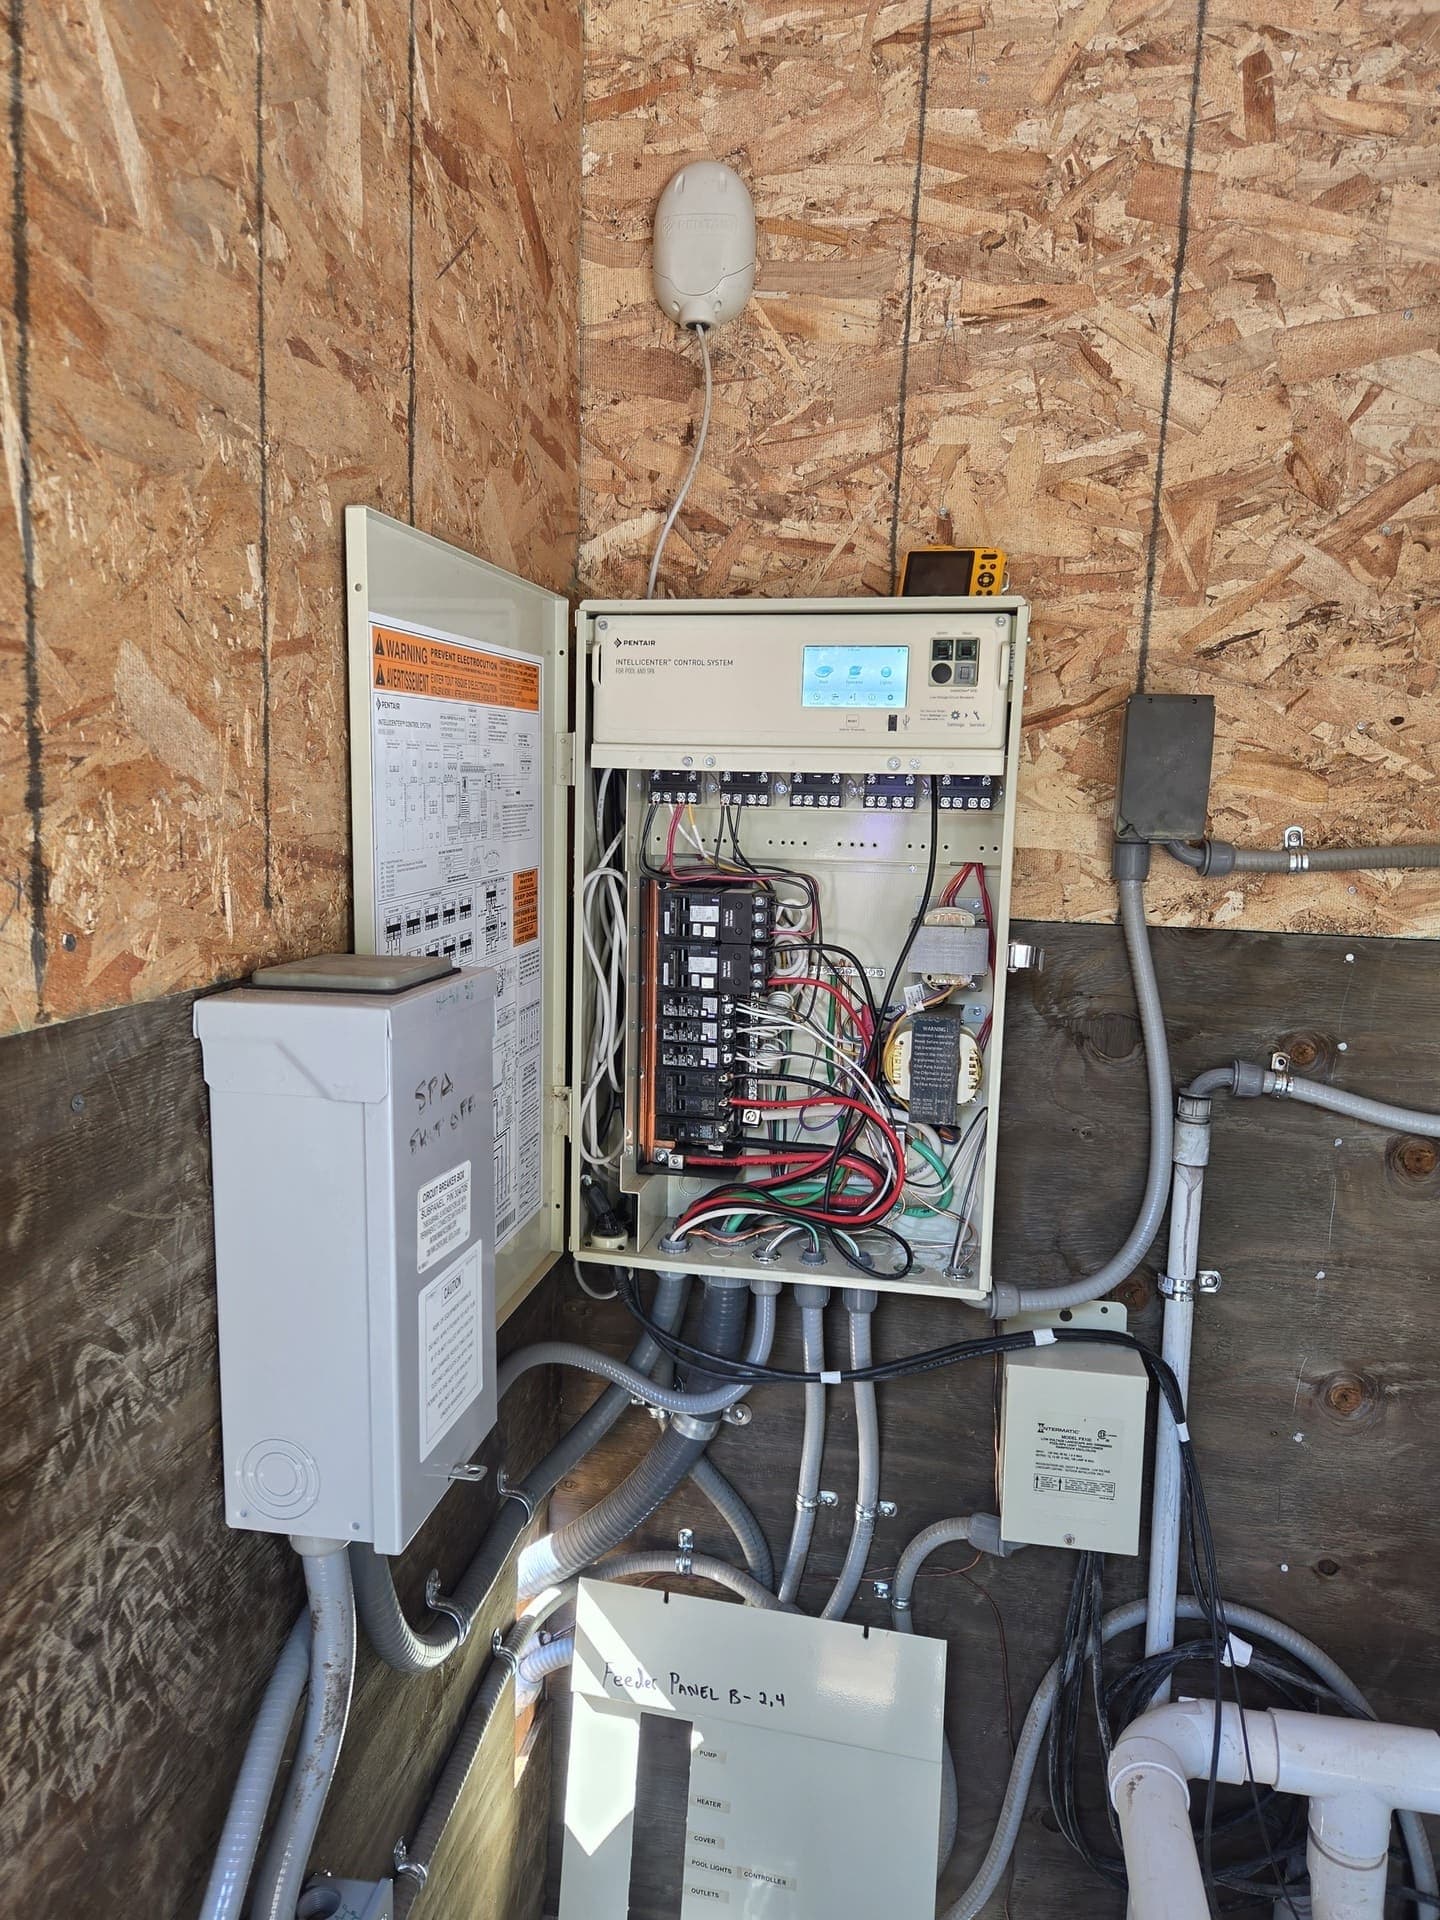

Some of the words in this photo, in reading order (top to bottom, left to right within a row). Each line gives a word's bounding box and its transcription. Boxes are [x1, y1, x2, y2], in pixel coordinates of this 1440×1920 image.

[385, 640, 428, 665] WARNING
[430, 648, 456, 663] PREVENT
[457, 653, 498, 670] ELECTROCUTION
[415, 1072, 454, 1113] SPA
[438, 1175, 456, 1194] BREAKER
[1038, 1422, 1080, 1434] INTERMATIC
[602, 1662, 658, 1690] Feeder
[670, 1672, 720, 1701] PANEL
[700, 1750, 718, 1759] PUMP
[696, 1798, 722, 1809] HEATER
[694, 1835, 716, 1845] COVER
[692, 1859, 709, 1870] POOL
[710, 1863, 732, 1875] LIGHTS
[744, 1870, 787, 1886] CONTROLLER
[690, 1888, 720, 1899] OUTLETS
